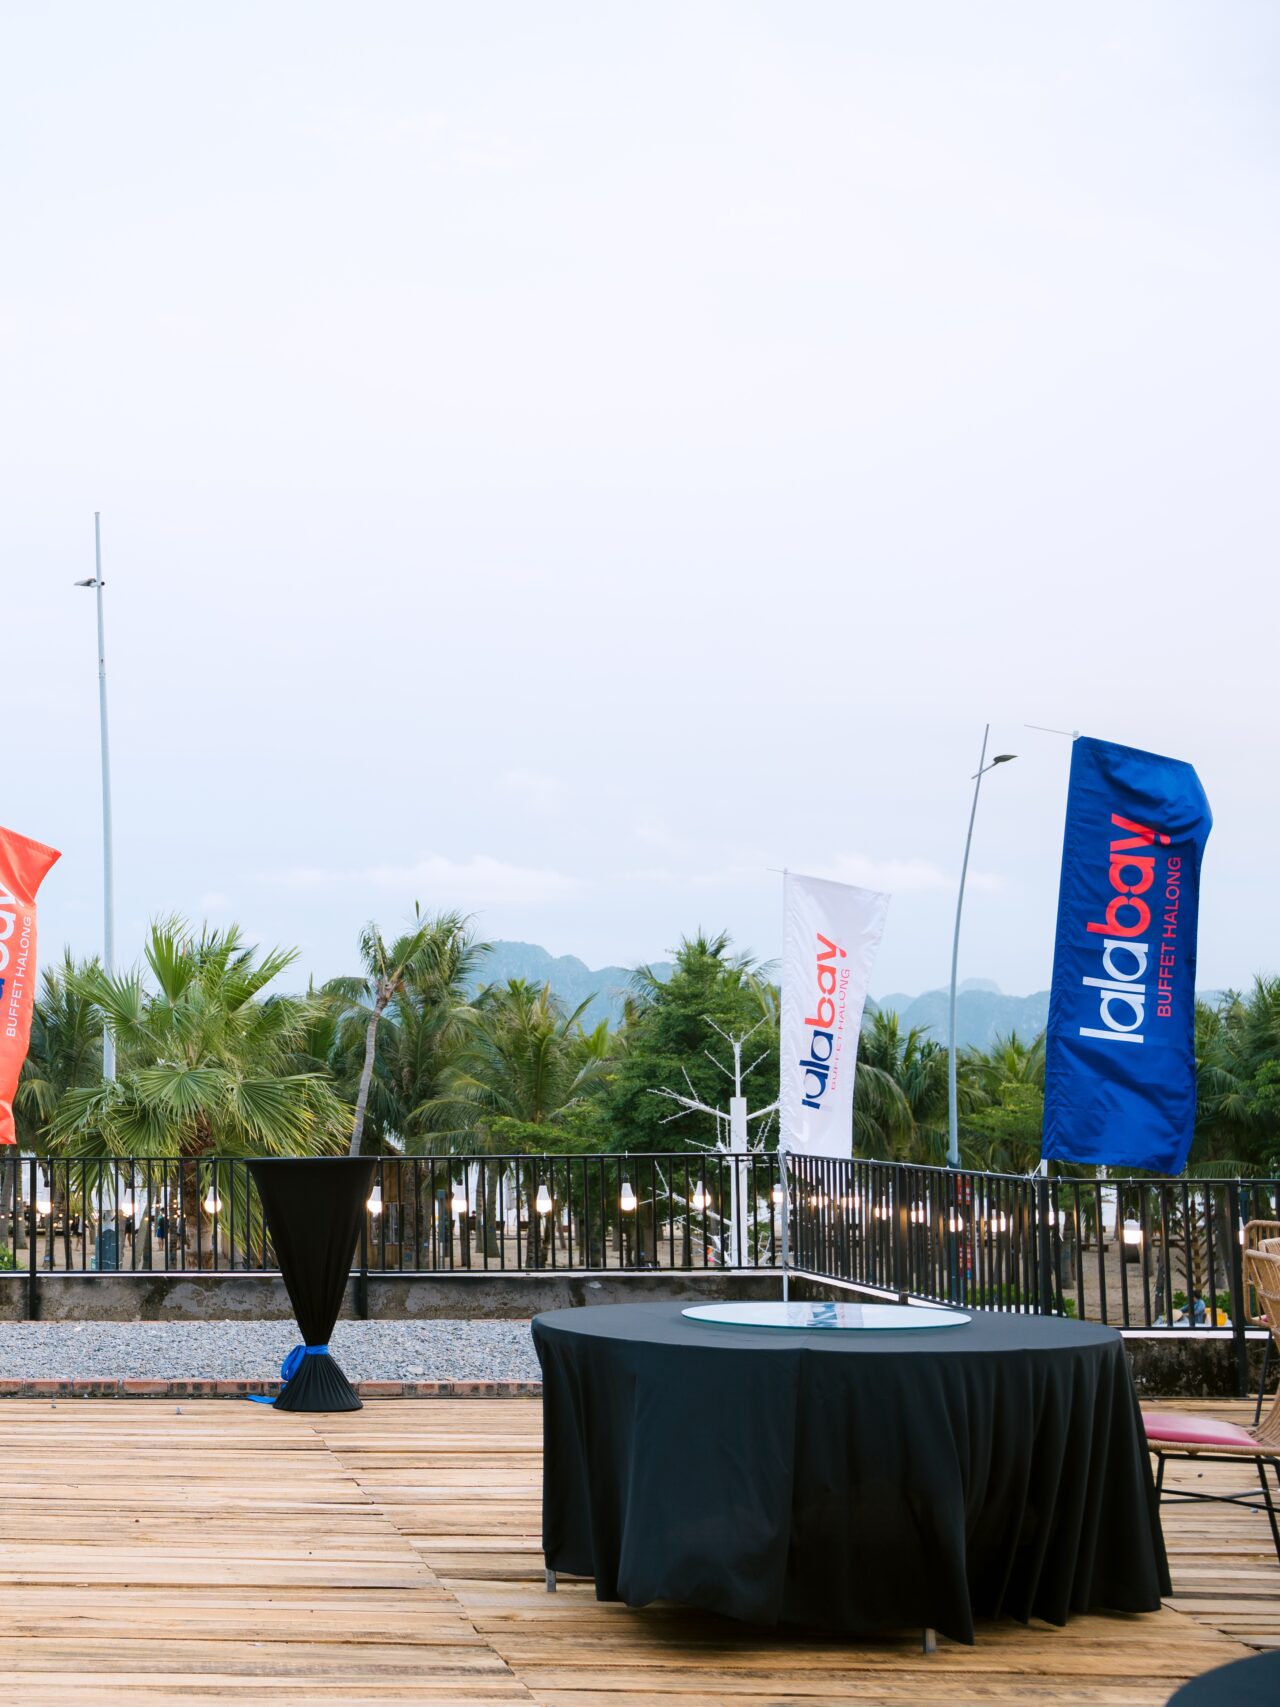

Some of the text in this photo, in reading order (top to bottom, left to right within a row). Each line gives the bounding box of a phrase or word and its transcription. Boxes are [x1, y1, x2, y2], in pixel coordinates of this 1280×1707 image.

[6, 916, 32, 1037] BUFFET HALONG
[1079, 813, 1170, 1044] lalabay
[1157, 857, 1181, 1017] BUFFET HALONG
